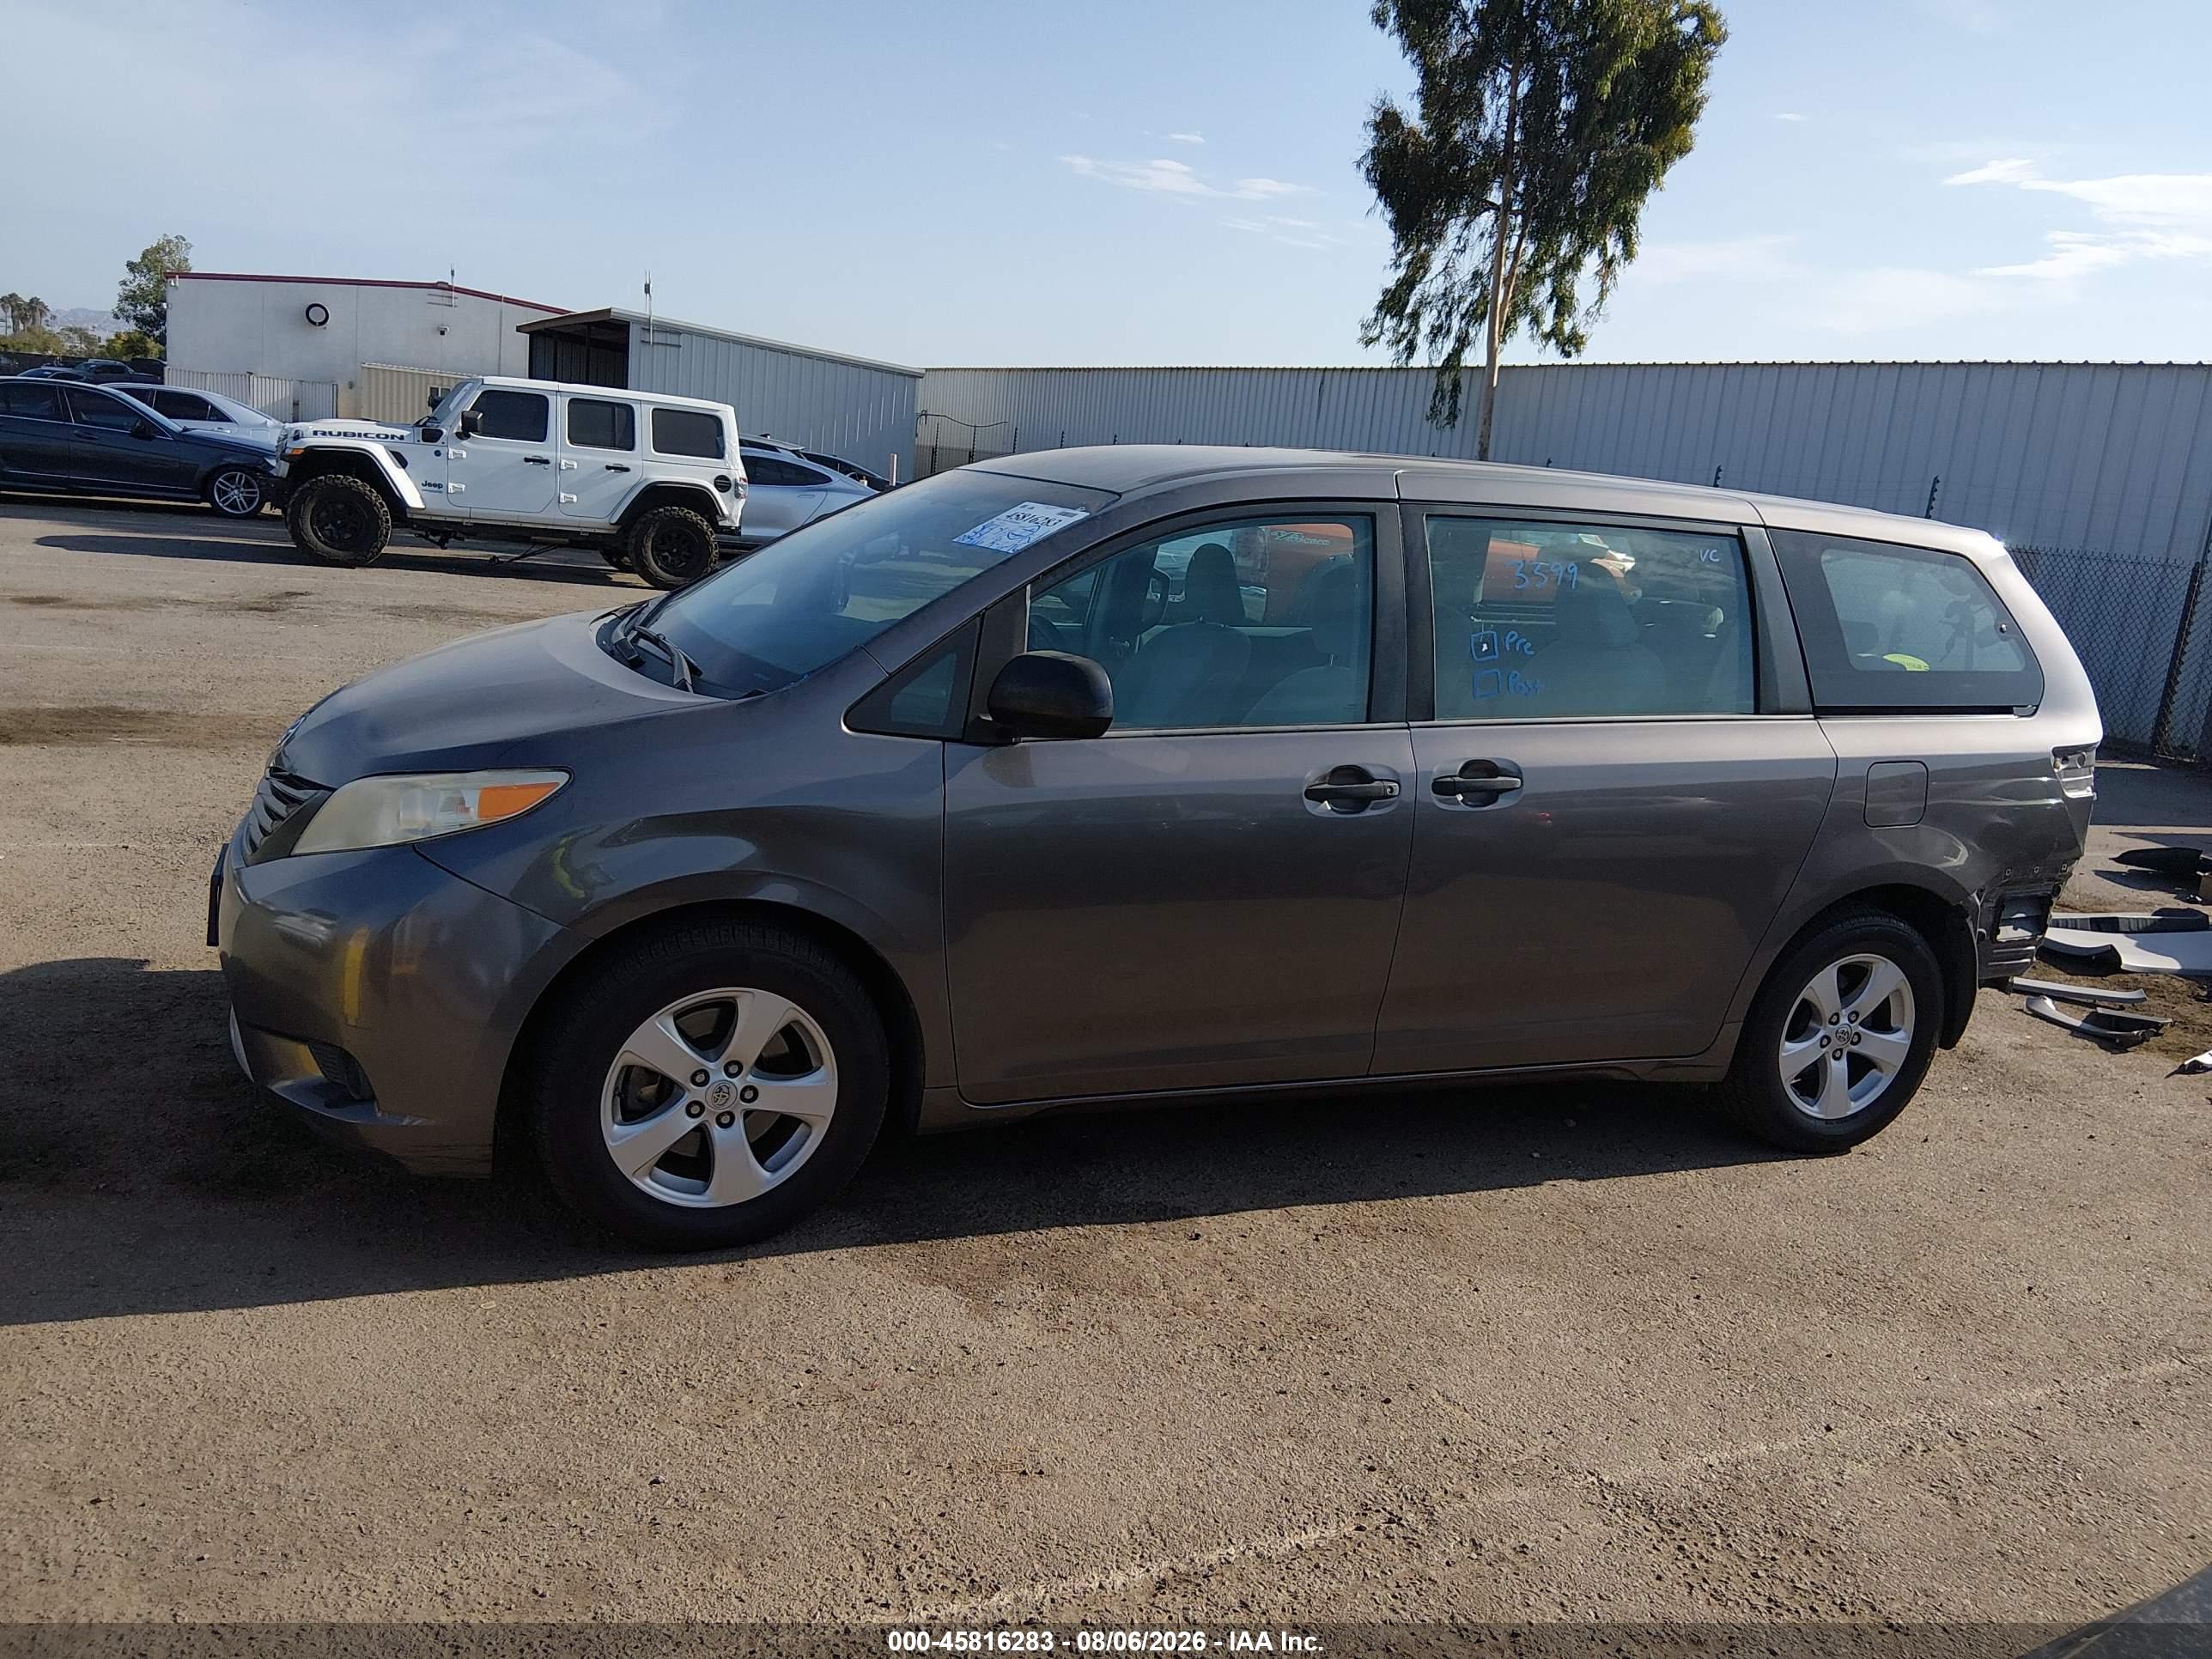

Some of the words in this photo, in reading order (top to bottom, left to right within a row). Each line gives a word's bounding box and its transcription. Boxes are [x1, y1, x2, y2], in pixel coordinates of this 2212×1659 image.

[313, 429, 404, 441] RUBICON
[421, 480, 444, 489] Jeep
[1005, 511, 1063, 527] 45816283
